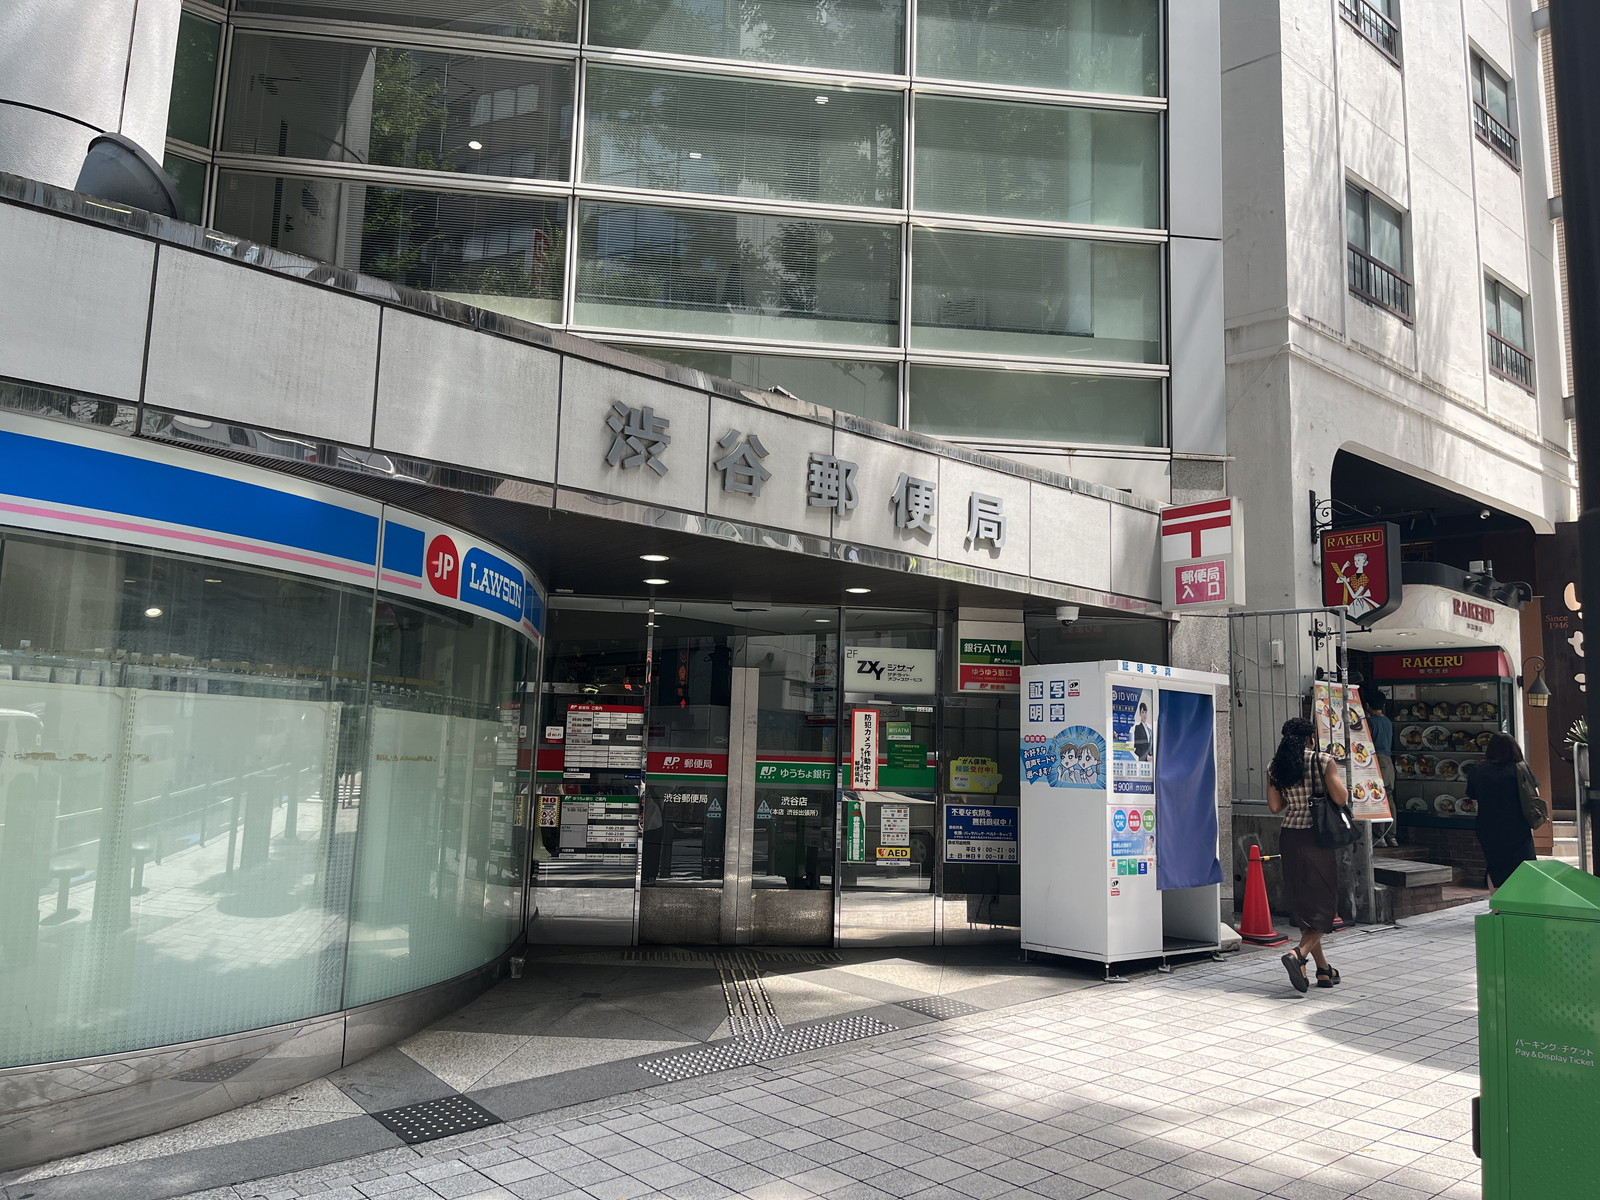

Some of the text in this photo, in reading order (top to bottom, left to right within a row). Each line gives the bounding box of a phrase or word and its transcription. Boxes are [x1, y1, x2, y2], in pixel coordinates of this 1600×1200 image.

[606, 400, 1007, 549] 渋谷郵便局
[1327, 532, 1380, 548] RAKERU
[432, 552, 454, 580] JP
[1181, 566, 1220, 585] 郵便局
[469, 562, 522, 609] LAWSON
[1181, 581, 1220, 599] 入口
[1453, 597, 1495, 625] RAKERU
[1545, 614, 1568, 622] Since
[1549, 621, 1569, 629] 1946
[846, 649, 858, 658] 2F
[963, 642, 1007, 654] 銀行ATM
[1122, 661, 1171, 677] 証明写真
[1402, 655, 1463, 668] RAKERU
[857, 660, 885, 680] ZXY
[863, 713, 872, 786] 防犯カメラ作動中です
[684, 759, 713, 769] 郵便局
[780, 769, 831, 780] ゆうちょ銀行
[663, 793, 708, 804] 渋谷郵便局
[781, 796, 808, 806] 渋谷店
[1115, 820, 1124, 828] OK
[887, 849, 908, 857] AED
[1515, 1039, 1594, 1056] パーキング・チケット
[1515, 1048, 1531, 1058] Pay
[1537, 1051, 1567, 1063] Display
[1569, 1056, 1594, 1067] Ticket
